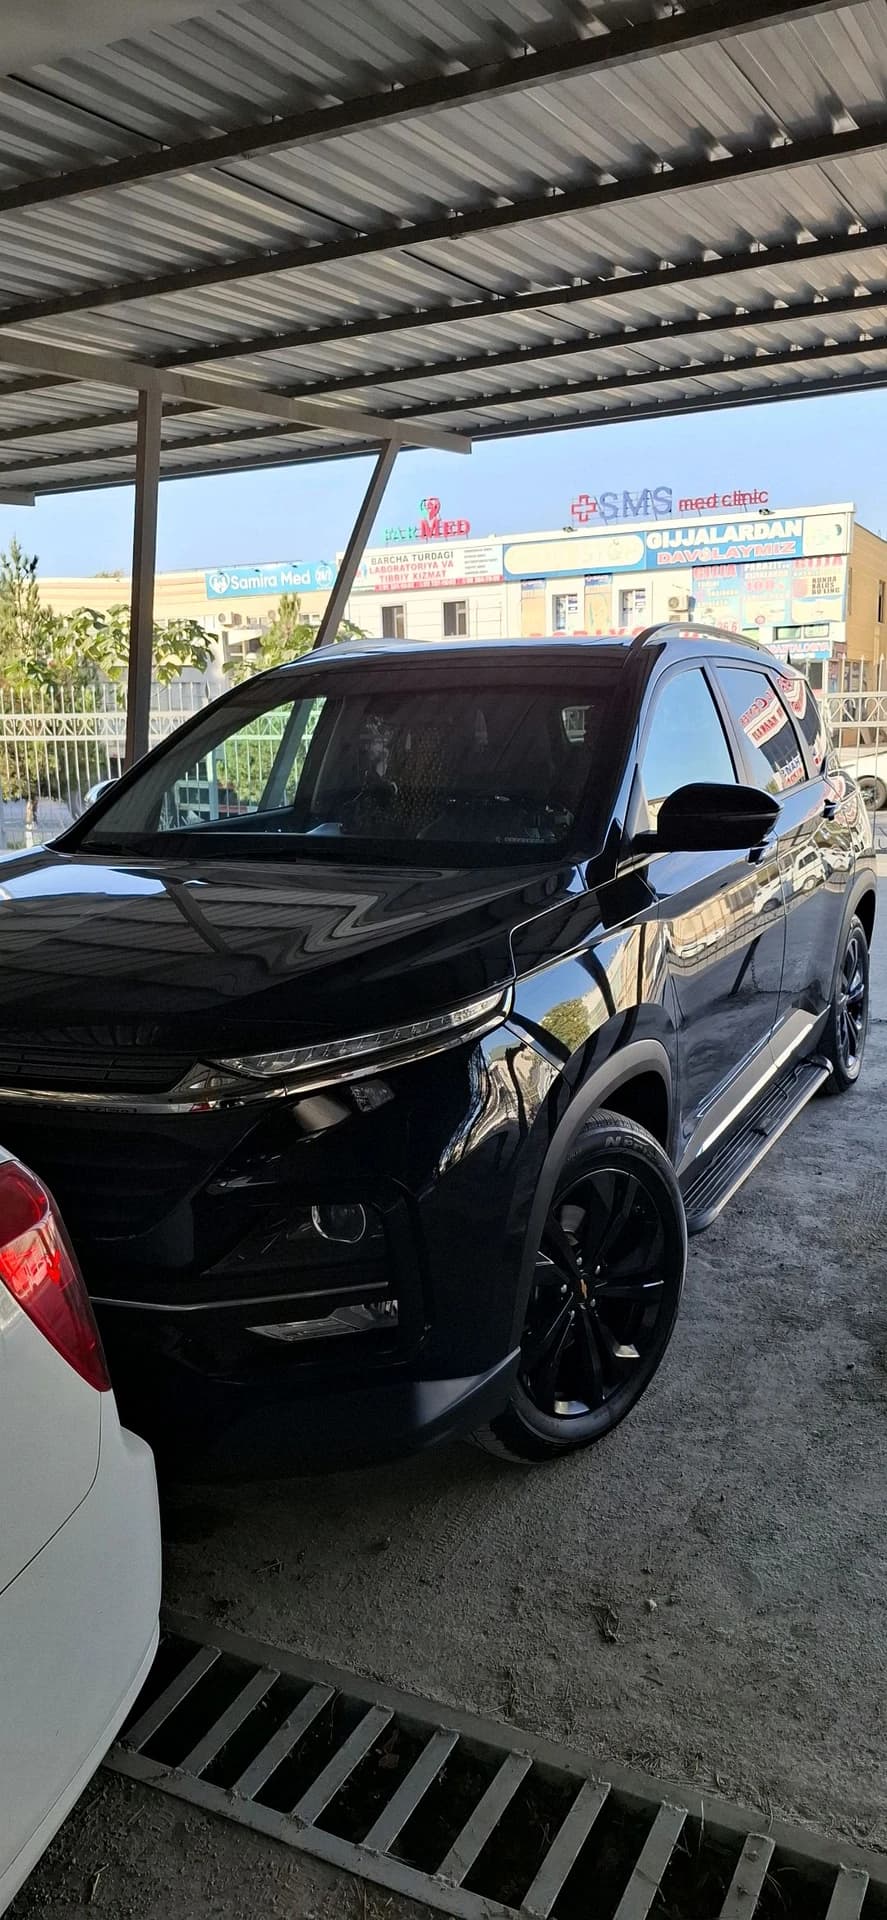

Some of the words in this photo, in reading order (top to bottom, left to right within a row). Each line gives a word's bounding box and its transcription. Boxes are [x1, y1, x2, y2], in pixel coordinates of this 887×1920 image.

[599, 486, 672, 520] SMS
[679, 493, 716, 511] med
[721, 489, 768, 507] clinic
[647, 519, 802, 549] GIJJALARDAN
[369, 563, 438, 574] LABORATORIYA
[442, 560, 454, 568] VA
[371, 555, 409, 566] BARCHA
[413, 551, 454, 562] TURDAGI
[231, 573, 277, 590] Samira
[281, 570, 311, 586] Med
[413, 570, 446, 580] XIZMAT
